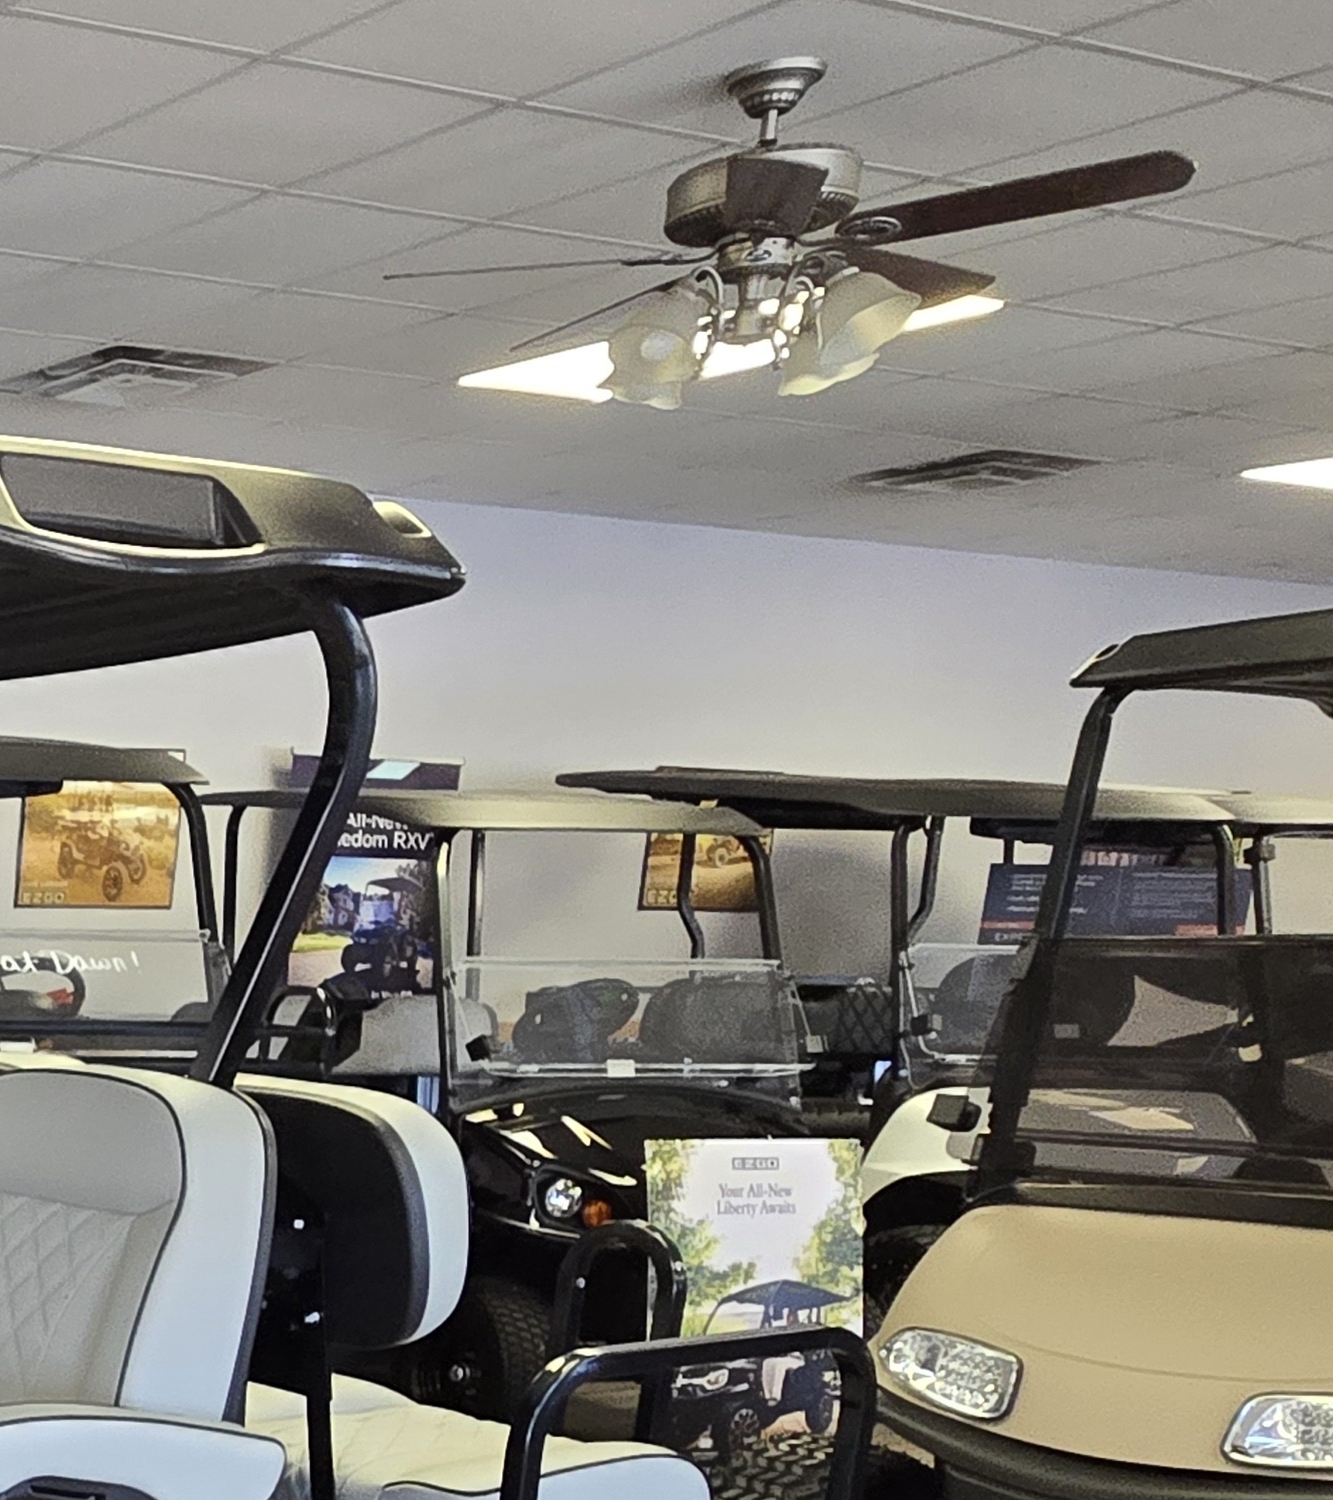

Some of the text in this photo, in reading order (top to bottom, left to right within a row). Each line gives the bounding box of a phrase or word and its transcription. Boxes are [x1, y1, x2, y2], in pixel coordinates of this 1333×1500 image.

[719, 1183, 793, 1199] Your All-New
[717, 1201, 797, 1219] Liberty Awaits
